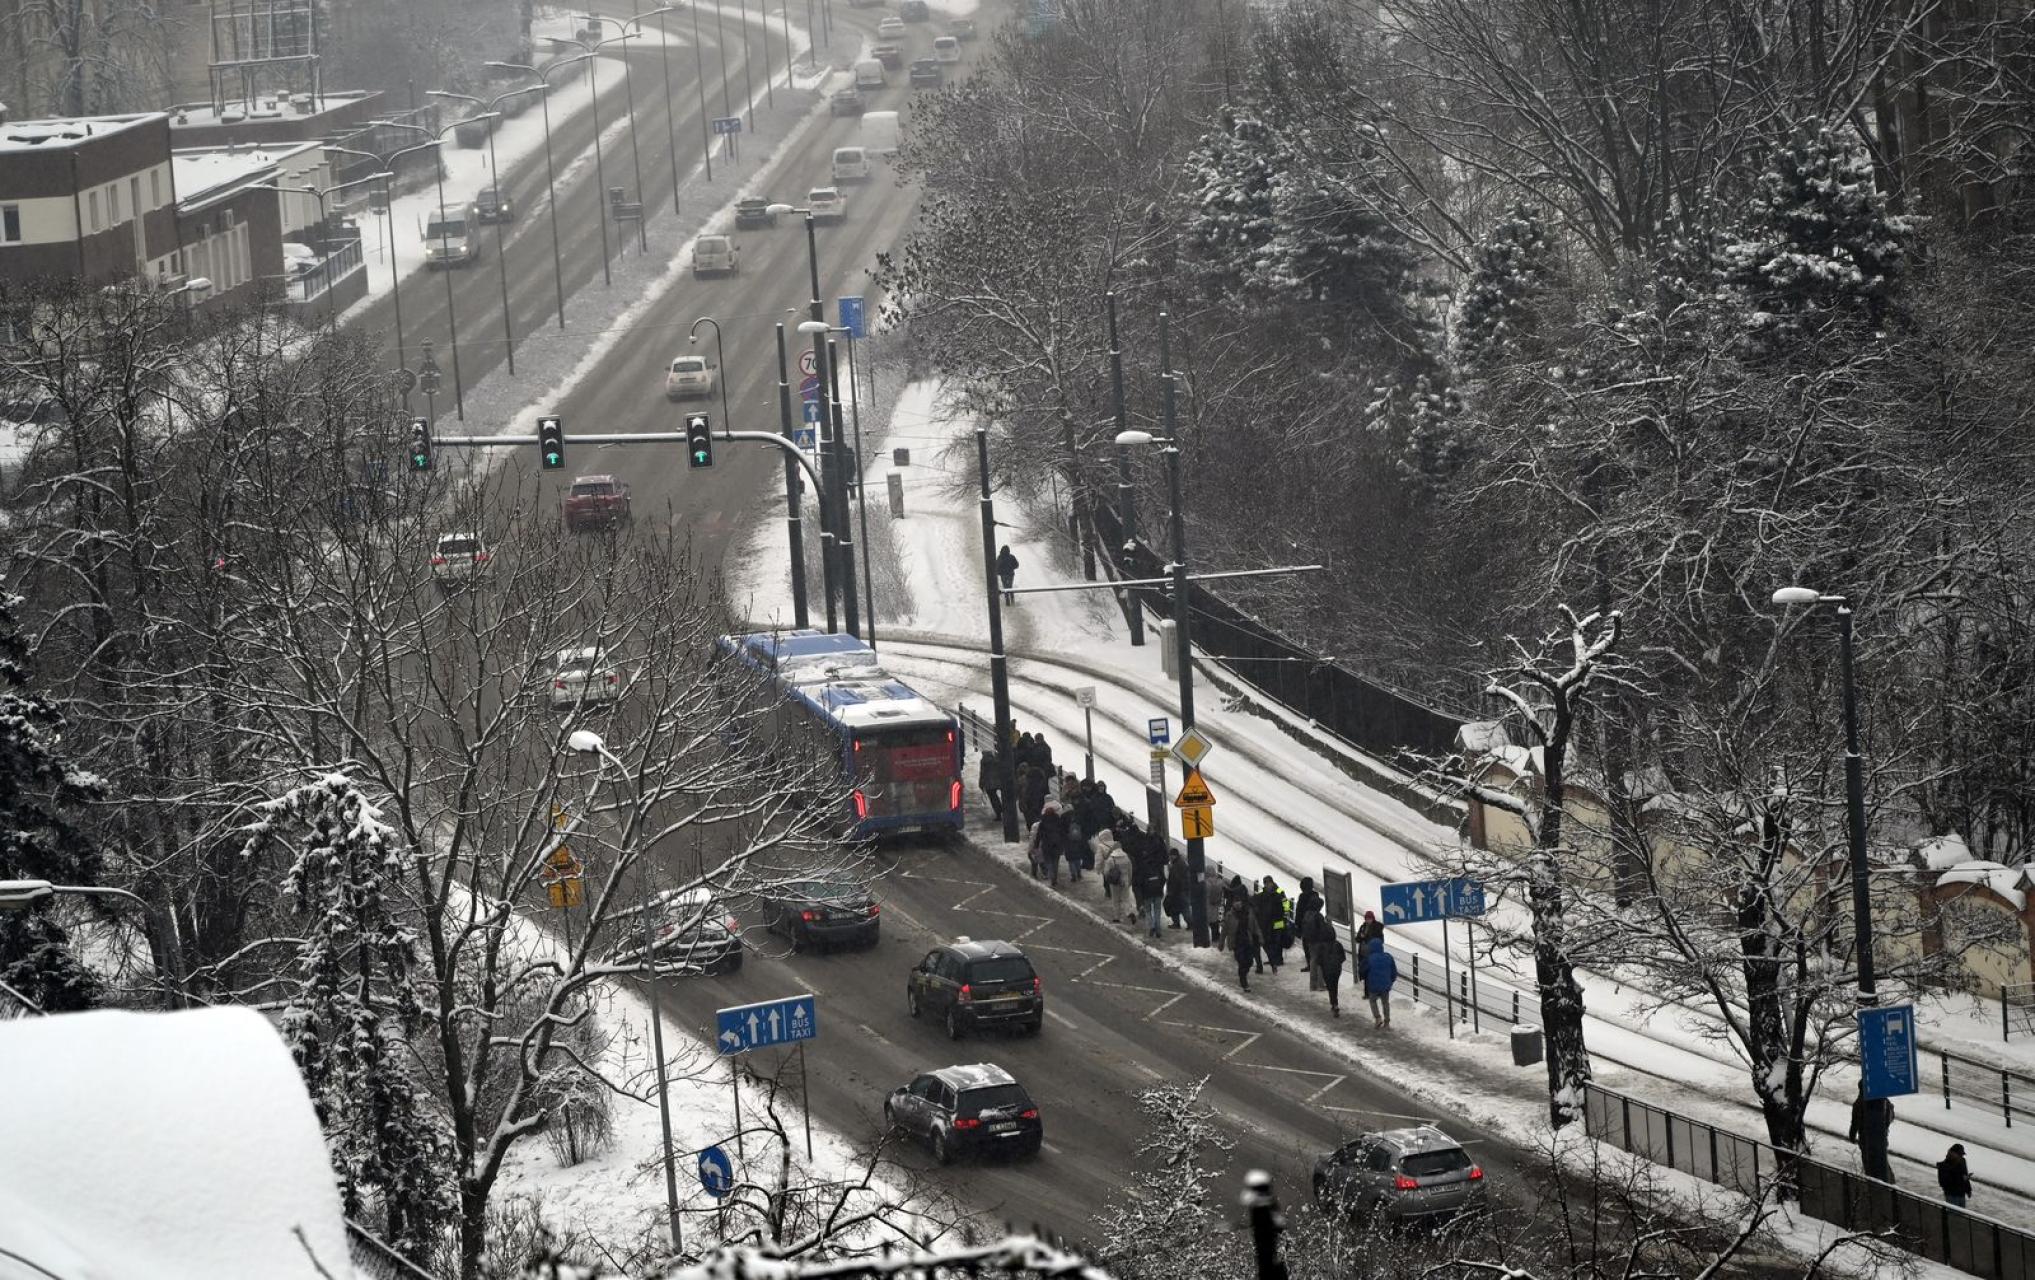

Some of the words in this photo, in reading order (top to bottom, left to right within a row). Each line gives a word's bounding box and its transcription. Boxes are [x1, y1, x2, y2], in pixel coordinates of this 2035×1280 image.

[1459, 895, 1479, 905] BUS
[791, 1017, 810, 1029] BUS
[790, 1027, 811, 1039] TAXI
